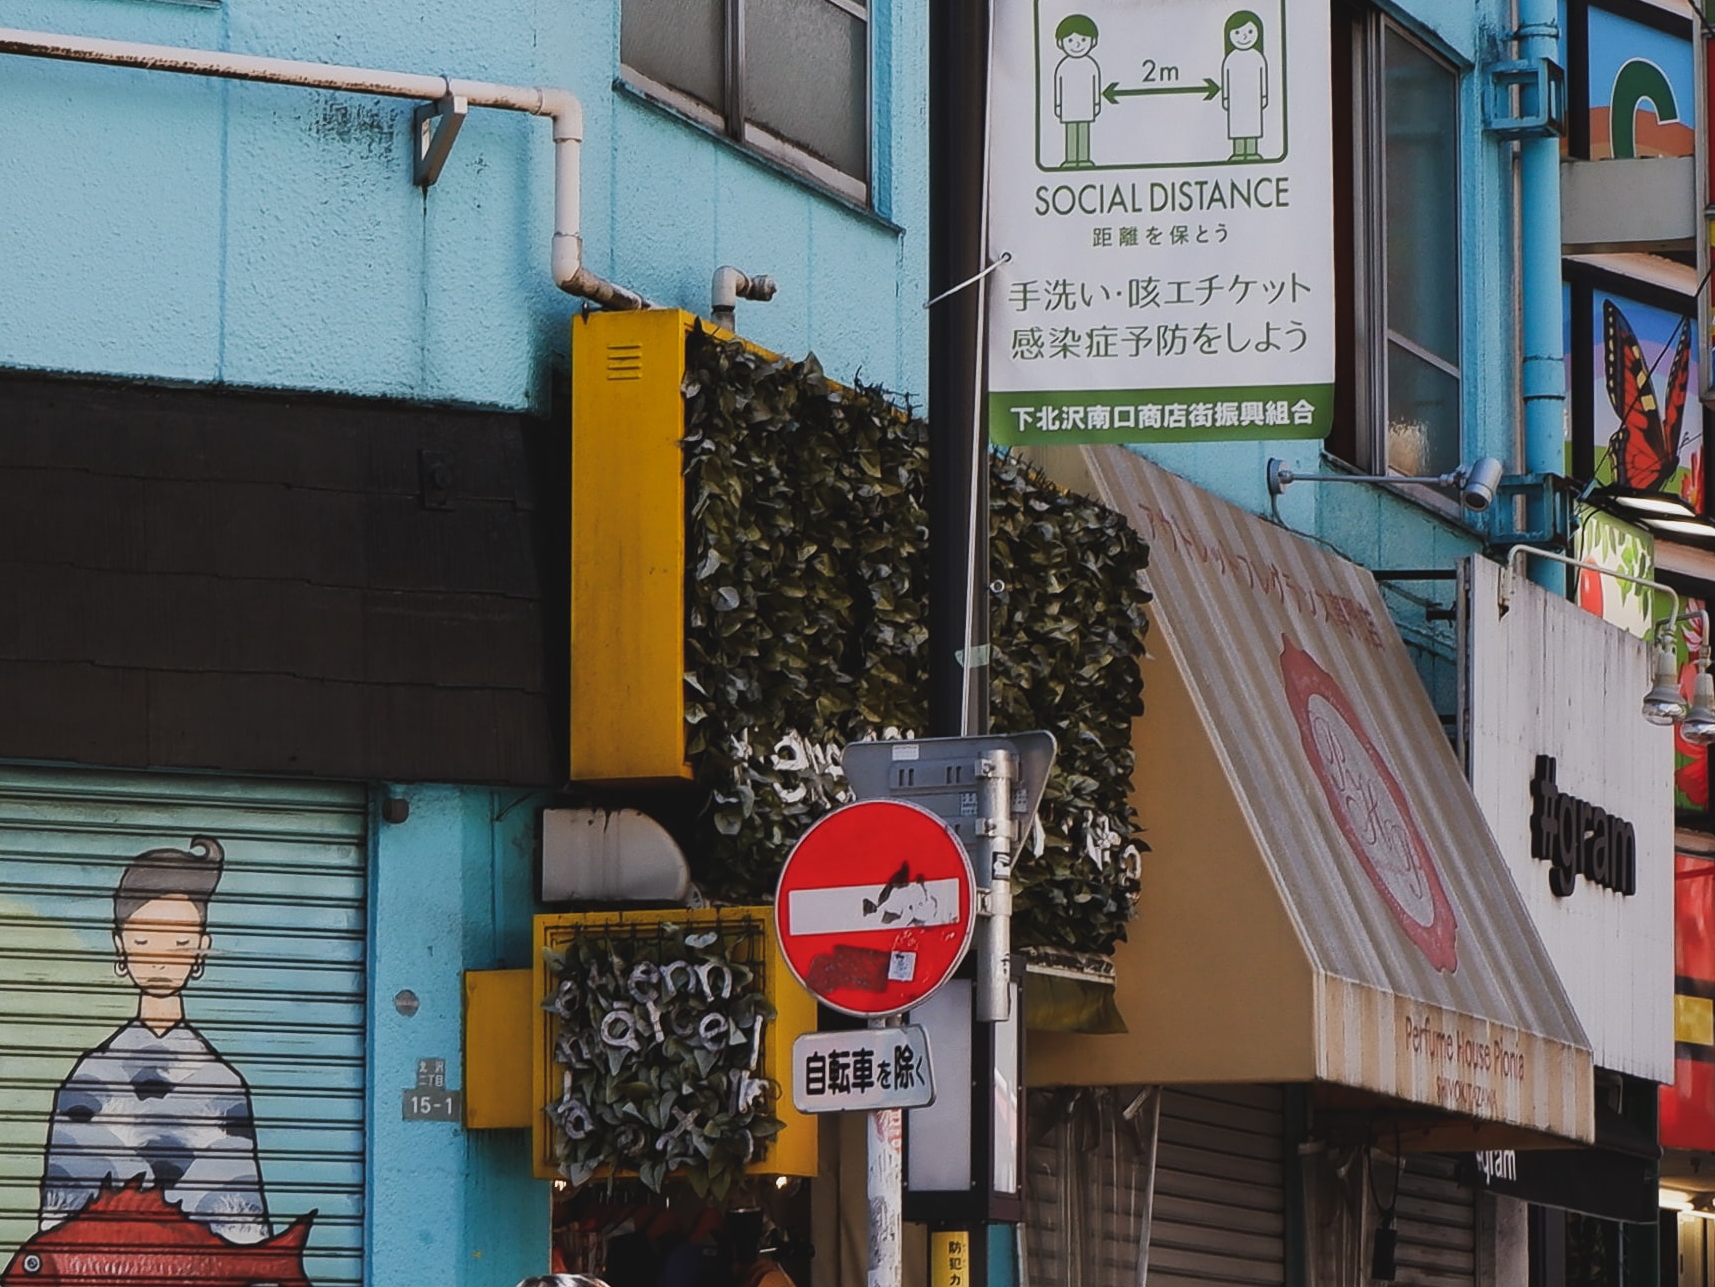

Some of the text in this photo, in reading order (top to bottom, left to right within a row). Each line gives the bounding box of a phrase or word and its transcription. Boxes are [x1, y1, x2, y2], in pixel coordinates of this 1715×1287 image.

[1141, 60, 1179, 83] 2m
[1035, 176, 1290, 216] SOCIAL DISTANCE
[1092, 223, 1229, 248] 距離を保とう
[1008, 272, 1312, 313] 手洗い・咳エチケット
[1011, 320, 1309, 361] 感染症予防をしよう
[1010, 399, 1316, 433] 下北沢南口商店街振興組合
[1529, 754, 1637, 897] #gram
[1405, 1015, 1454, 1063] Perfume
[1456, 1029, 1491, 1071] House
[418, 1074, 445, 1088] 二丁目
[804, 1043, 927, 1096] 自転車を除く
[410, 1095, 453, 1116] 15-1
